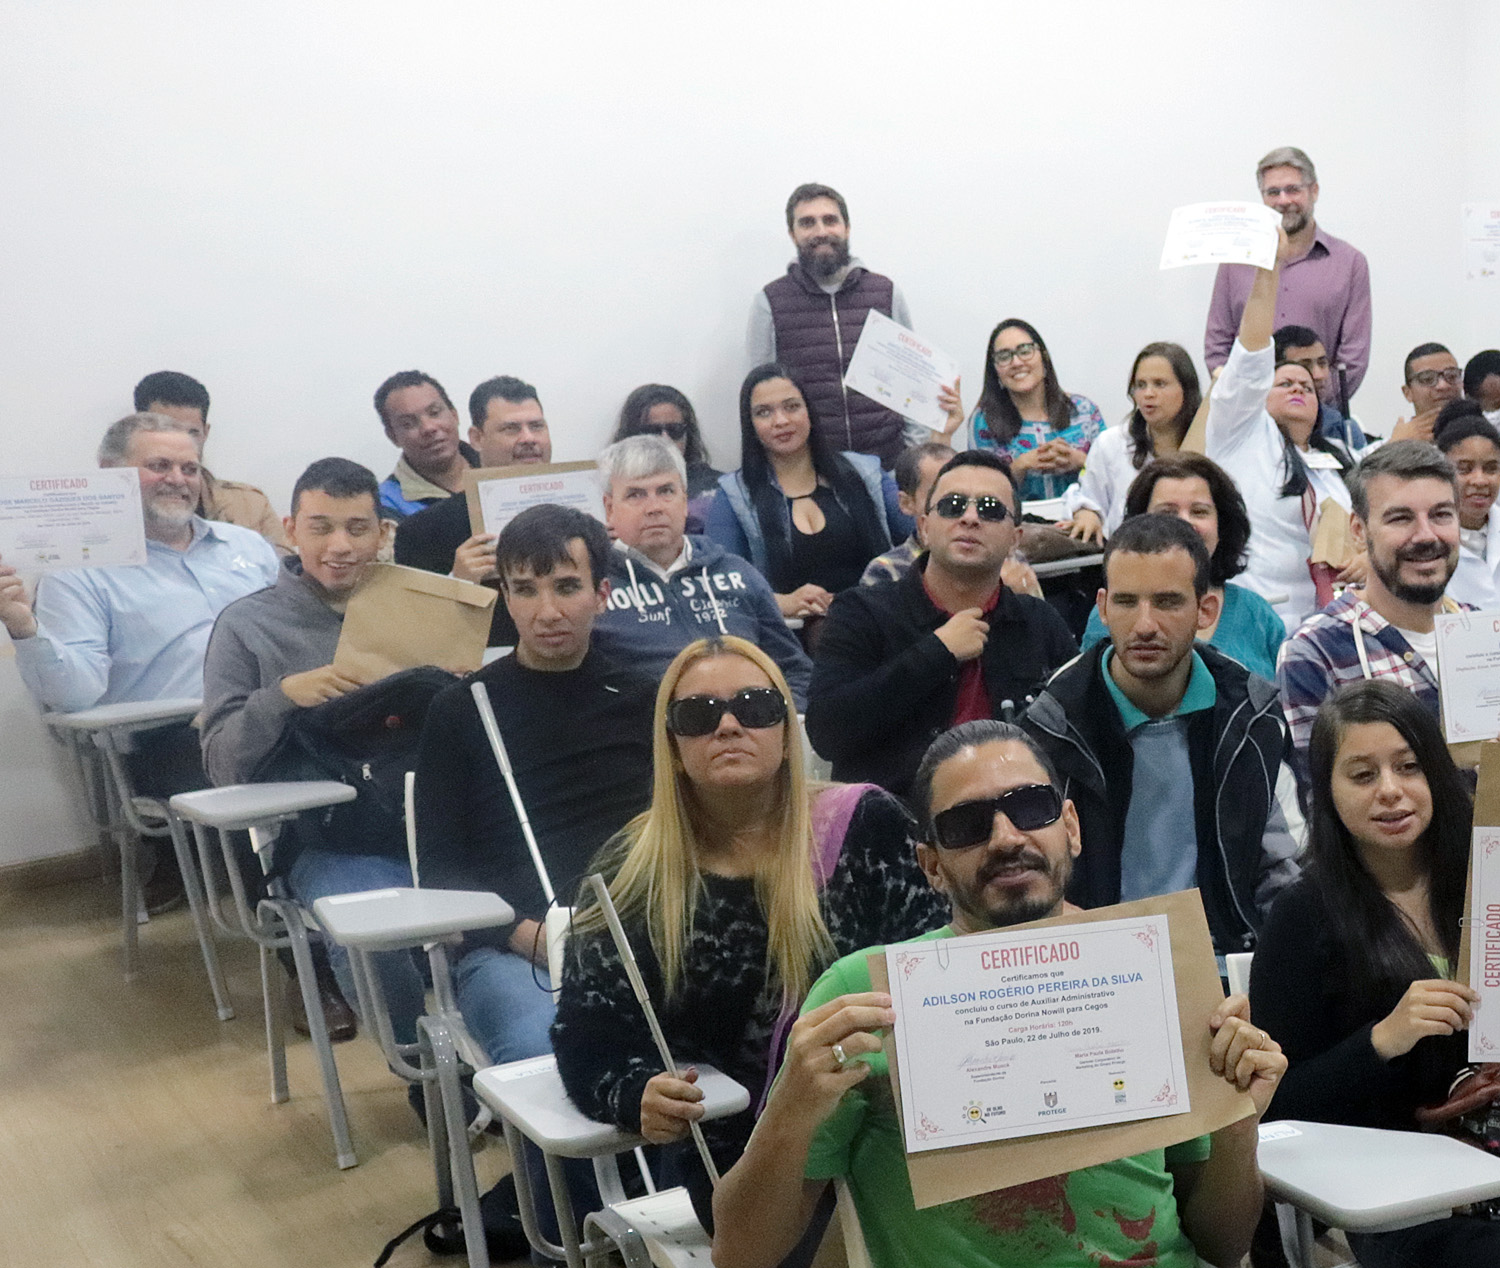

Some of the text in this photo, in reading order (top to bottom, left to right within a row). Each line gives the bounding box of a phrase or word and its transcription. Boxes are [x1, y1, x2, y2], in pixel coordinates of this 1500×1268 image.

[29, 477, 88, 491] CERTIFICADO
[638, 607, 671, 625] Surf
[980, 940, 1080, 971] CERTIFICADO
[1000, 969, 1064, 983] Certificamos que
[921, 972, 1143, 1007] ADILSON ROGÉRIO PEREIRA DA SILVA
[954, 1004, 988, 1015] concluiu
[996, 1002, 1018, 1010] curso
[1019, 999, 1029, 1007] de
[1030, 996, 1059, 1006] Auxiliar
[1060, 989, 1115, 1002] Administrativo
[975, 1013, 1013, 1026] Fundação
[1014, 1010, 1039, 1019] Dorina
[1041, 1007, 1064, 1016] Nowill
[1066, 1006, 1083, 1014] para
[1084, 1002, 1108, 1012] Cegos
[984, 1038, 999, 1047] São
[1001, 1035, 1025, 1046] Paulo,
[1026, 1034, 1035, 1042] 22
[1048, 1030, 1069, 1039] Julho
[1071, 1028, 1081, 1036] de
[1082, 1026, 1102, 1035] 2019.
[1008, 1025, 1028, 1034] Carga
[1037, 1107, 1066, 1116] PROTEGE
